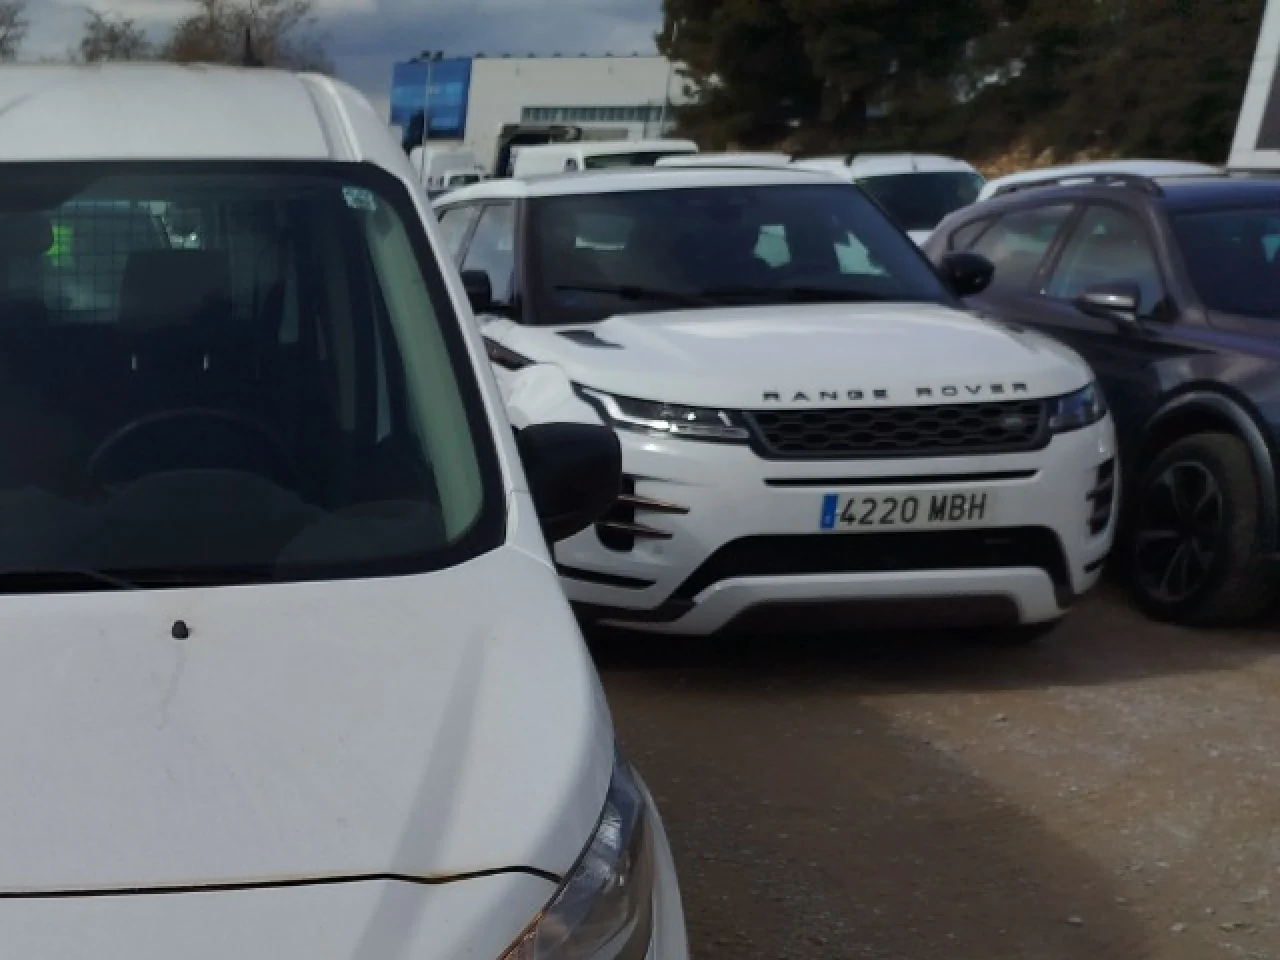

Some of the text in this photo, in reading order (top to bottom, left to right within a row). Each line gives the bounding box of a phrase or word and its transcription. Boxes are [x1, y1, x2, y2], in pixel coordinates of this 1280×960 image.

[762, 382, 1028, 402] RANGE ROVER
[839, 493, 987, 526] 4220 MBH
